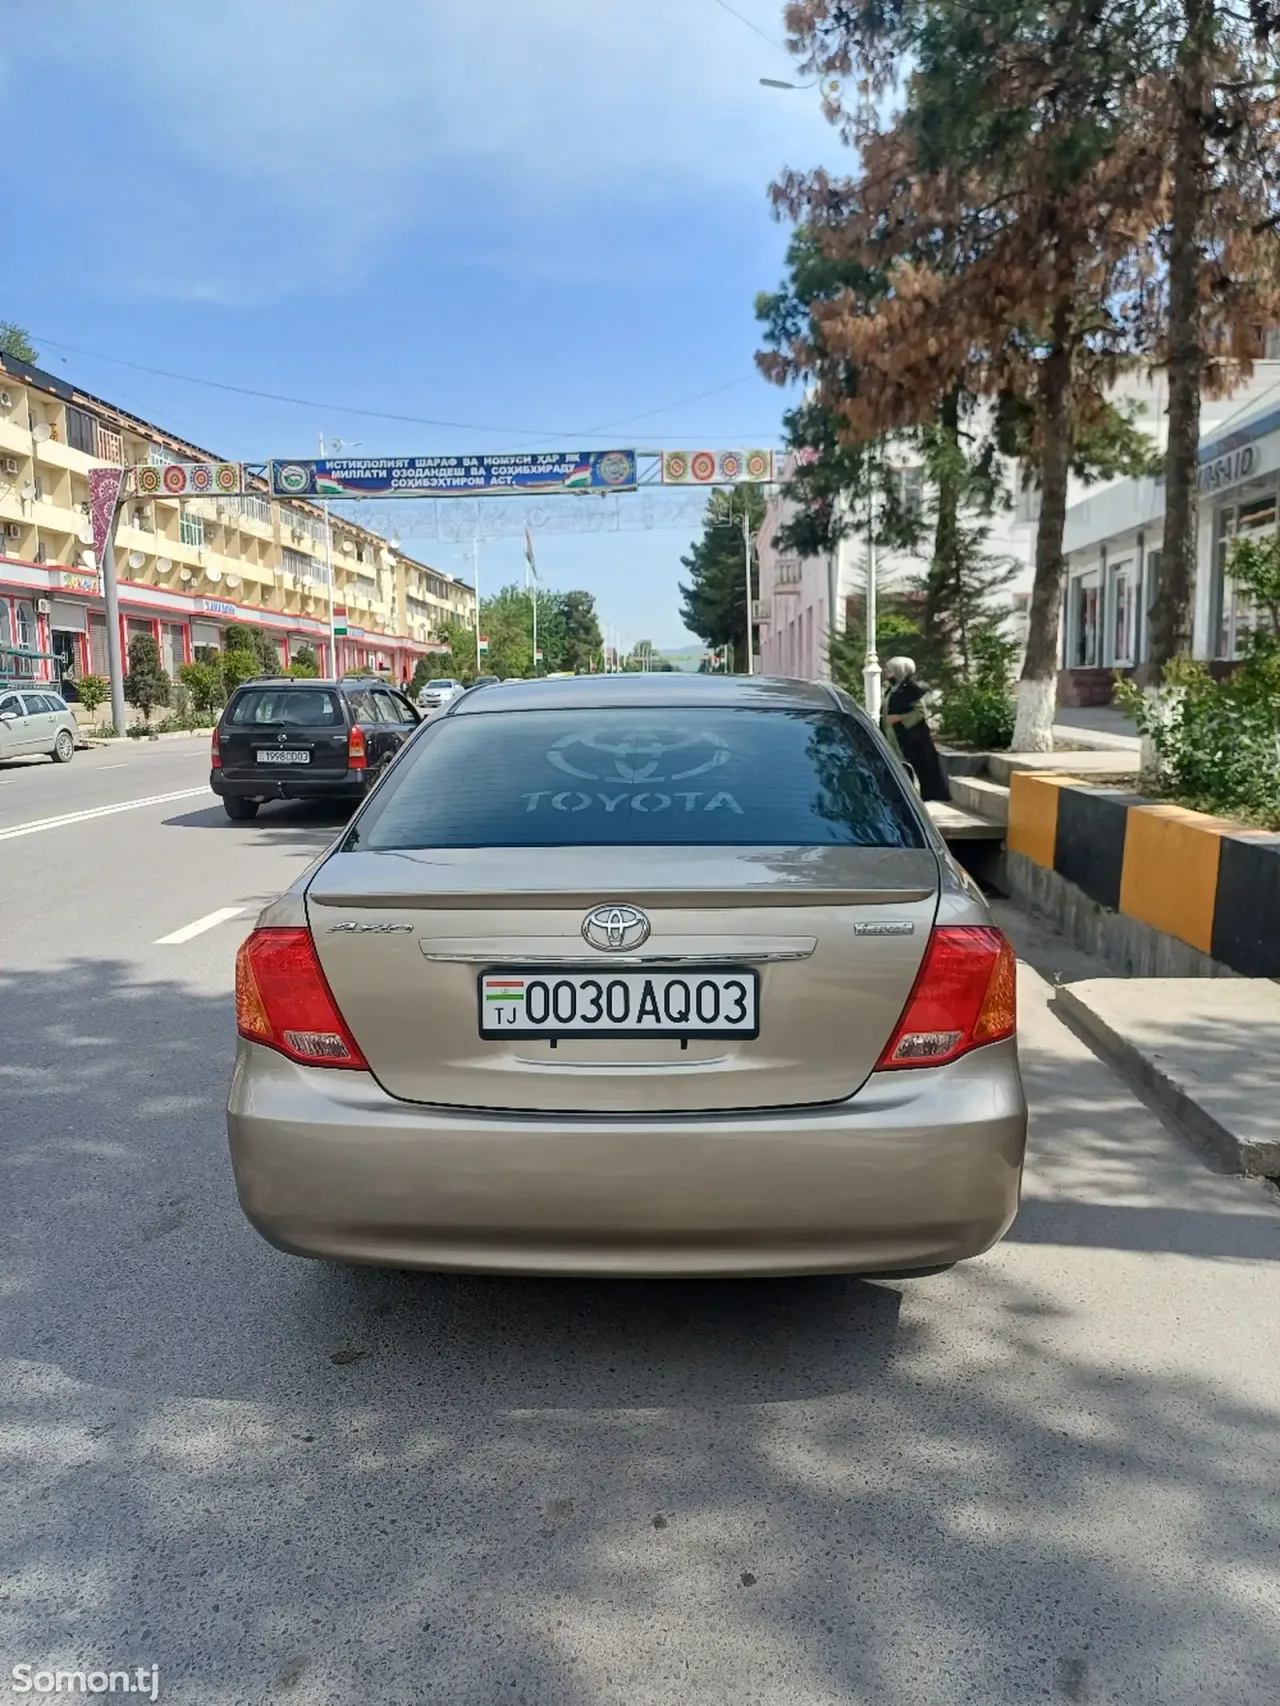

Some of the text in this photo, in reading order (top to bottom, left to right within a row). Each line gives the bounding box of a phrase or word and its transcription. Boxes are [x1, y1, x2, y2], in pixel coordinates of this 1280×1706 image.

[326, 459, 409, 470] ИСТИҚЛОЛИЯТ
[415, 458, 457, 468] ШАРАФ
[463, 458, 479, 467] ВА
[484, 456, 531, 466] НОМУСИ
[331, 470, 387, 479] МИЛЛАТИ
[392, 467, 465, 478] ОЗОДАНДЕШ
[470, 467, 486, 476] ВА
[520, 790, 745, 814] TOYOTA
[494, 979, 748, 1025] TJ 0030AQ03
